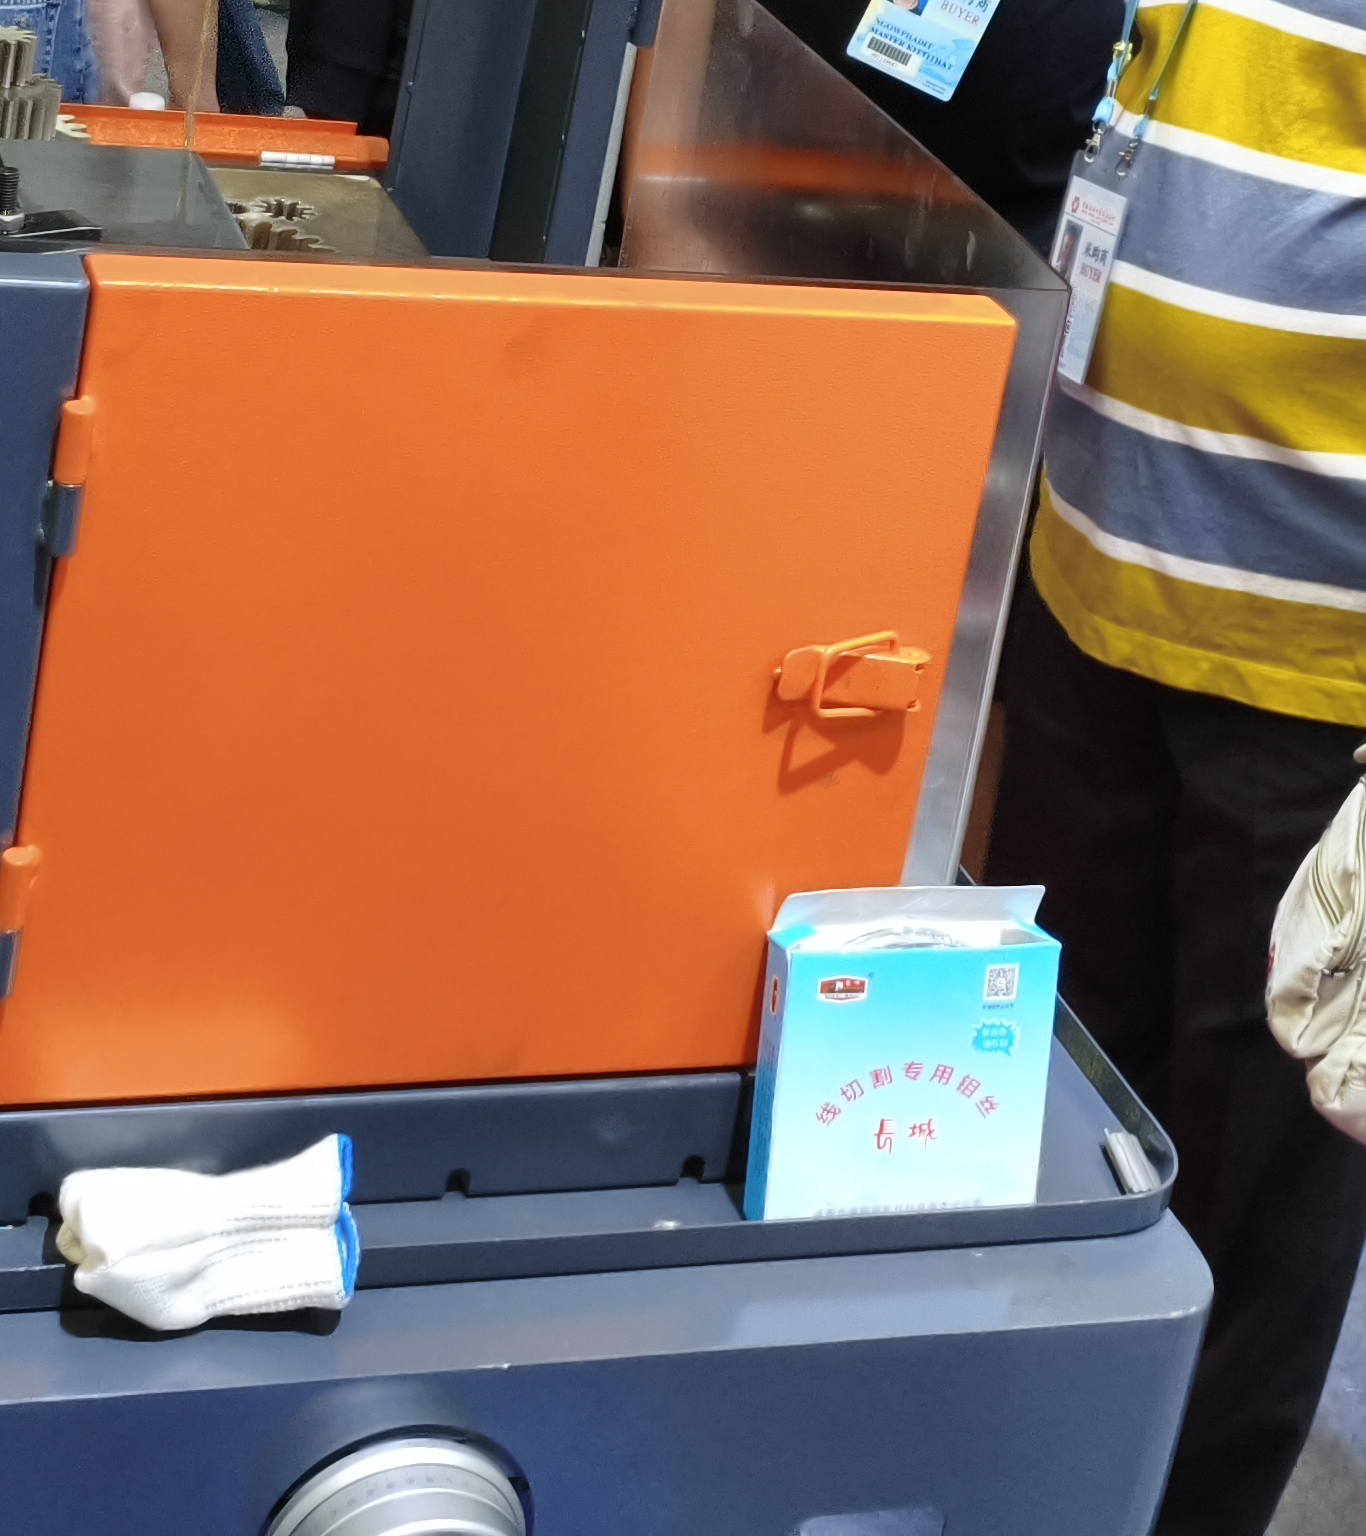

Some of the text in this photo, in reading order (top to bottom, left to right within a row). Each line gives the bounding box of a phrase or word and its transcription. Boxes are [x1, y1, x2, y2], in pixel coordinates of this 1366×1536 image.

[940, 0, 981, 25] BUYER
[815, 1060, 1000, 1127] 线切割专用钼丝
